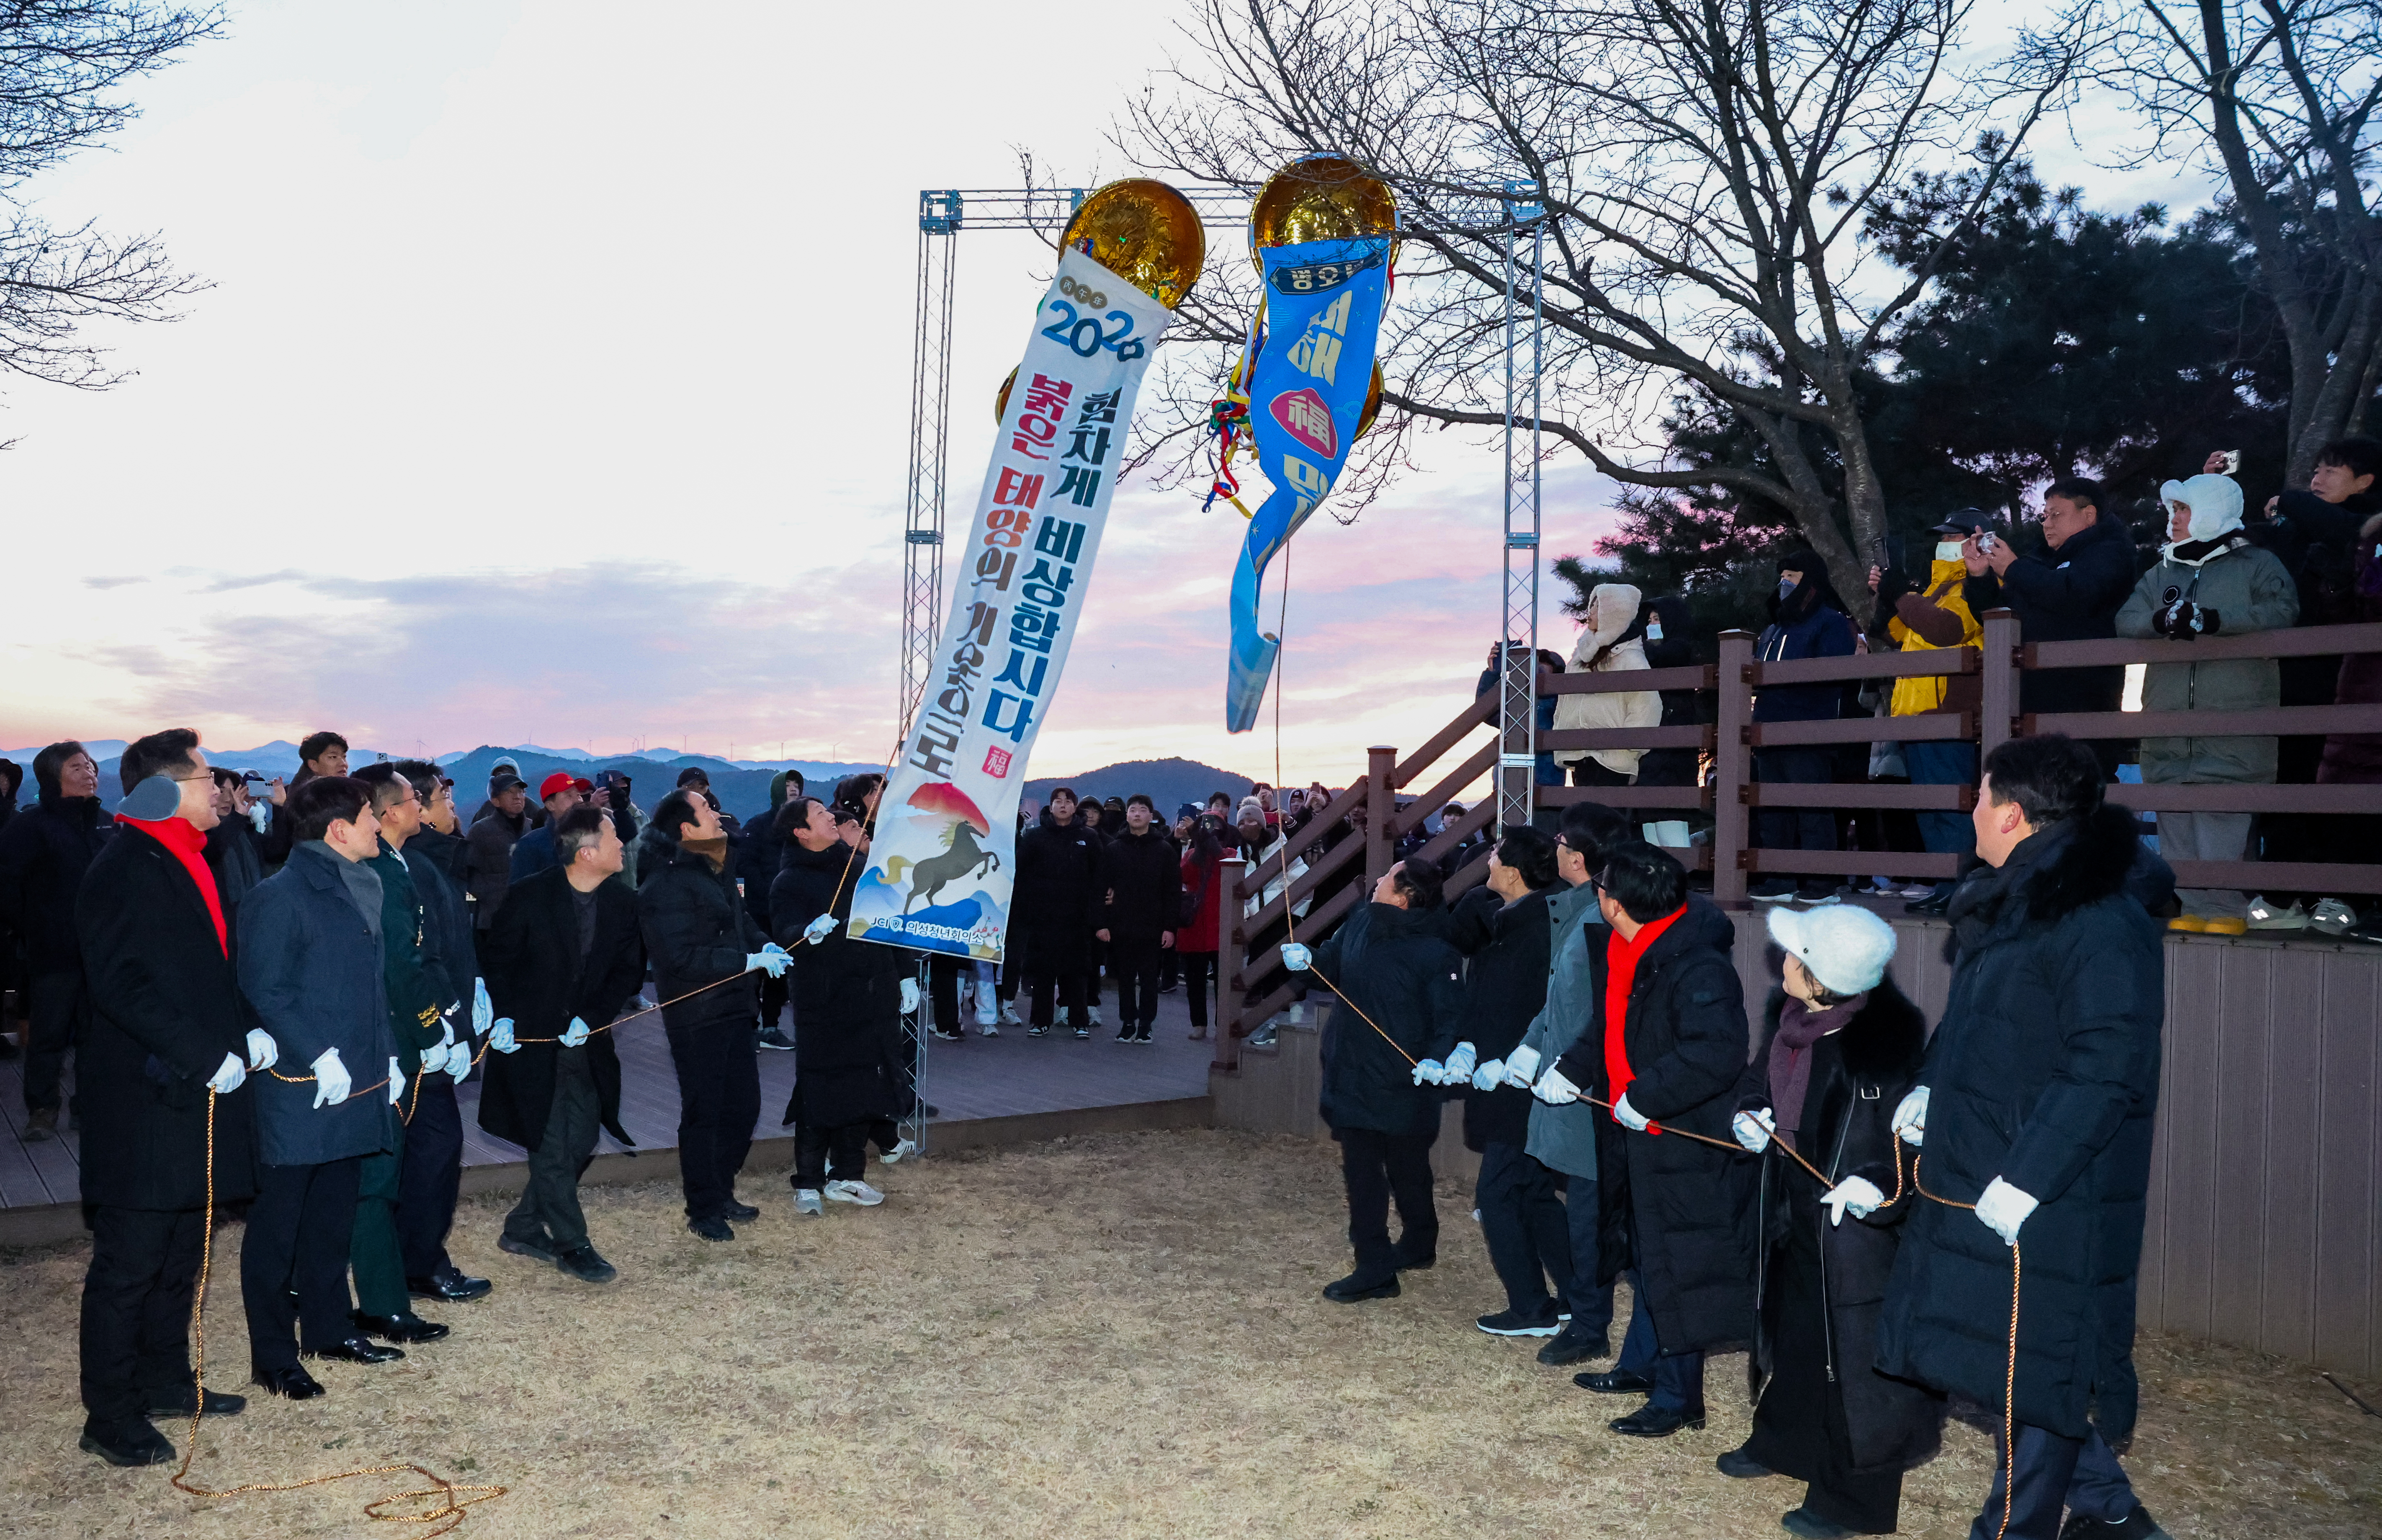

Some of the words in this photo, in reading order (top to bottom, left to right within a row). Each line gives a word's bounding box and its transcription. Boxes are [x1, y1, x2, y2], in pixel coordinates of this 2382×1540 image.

[1063, 279, 1103, 306] 丙午年
[1041, 300, 1146, 362] 2026
[1012, 373, 1073, 461] 붉은
[1050, 386, 1123, 507] 힘차게
[1288, 395, 1330, 451] 福
[971, 466, 1045, 591] 태양의
[981, 516, 1086, 742] 비상합시다
[909, 601, 998, 779] 기운으로
[987, 749, 1009, 776] 福
[871, 917, 888, 929] JCI
[906, 921, 984, 944] 의성청년회의소
